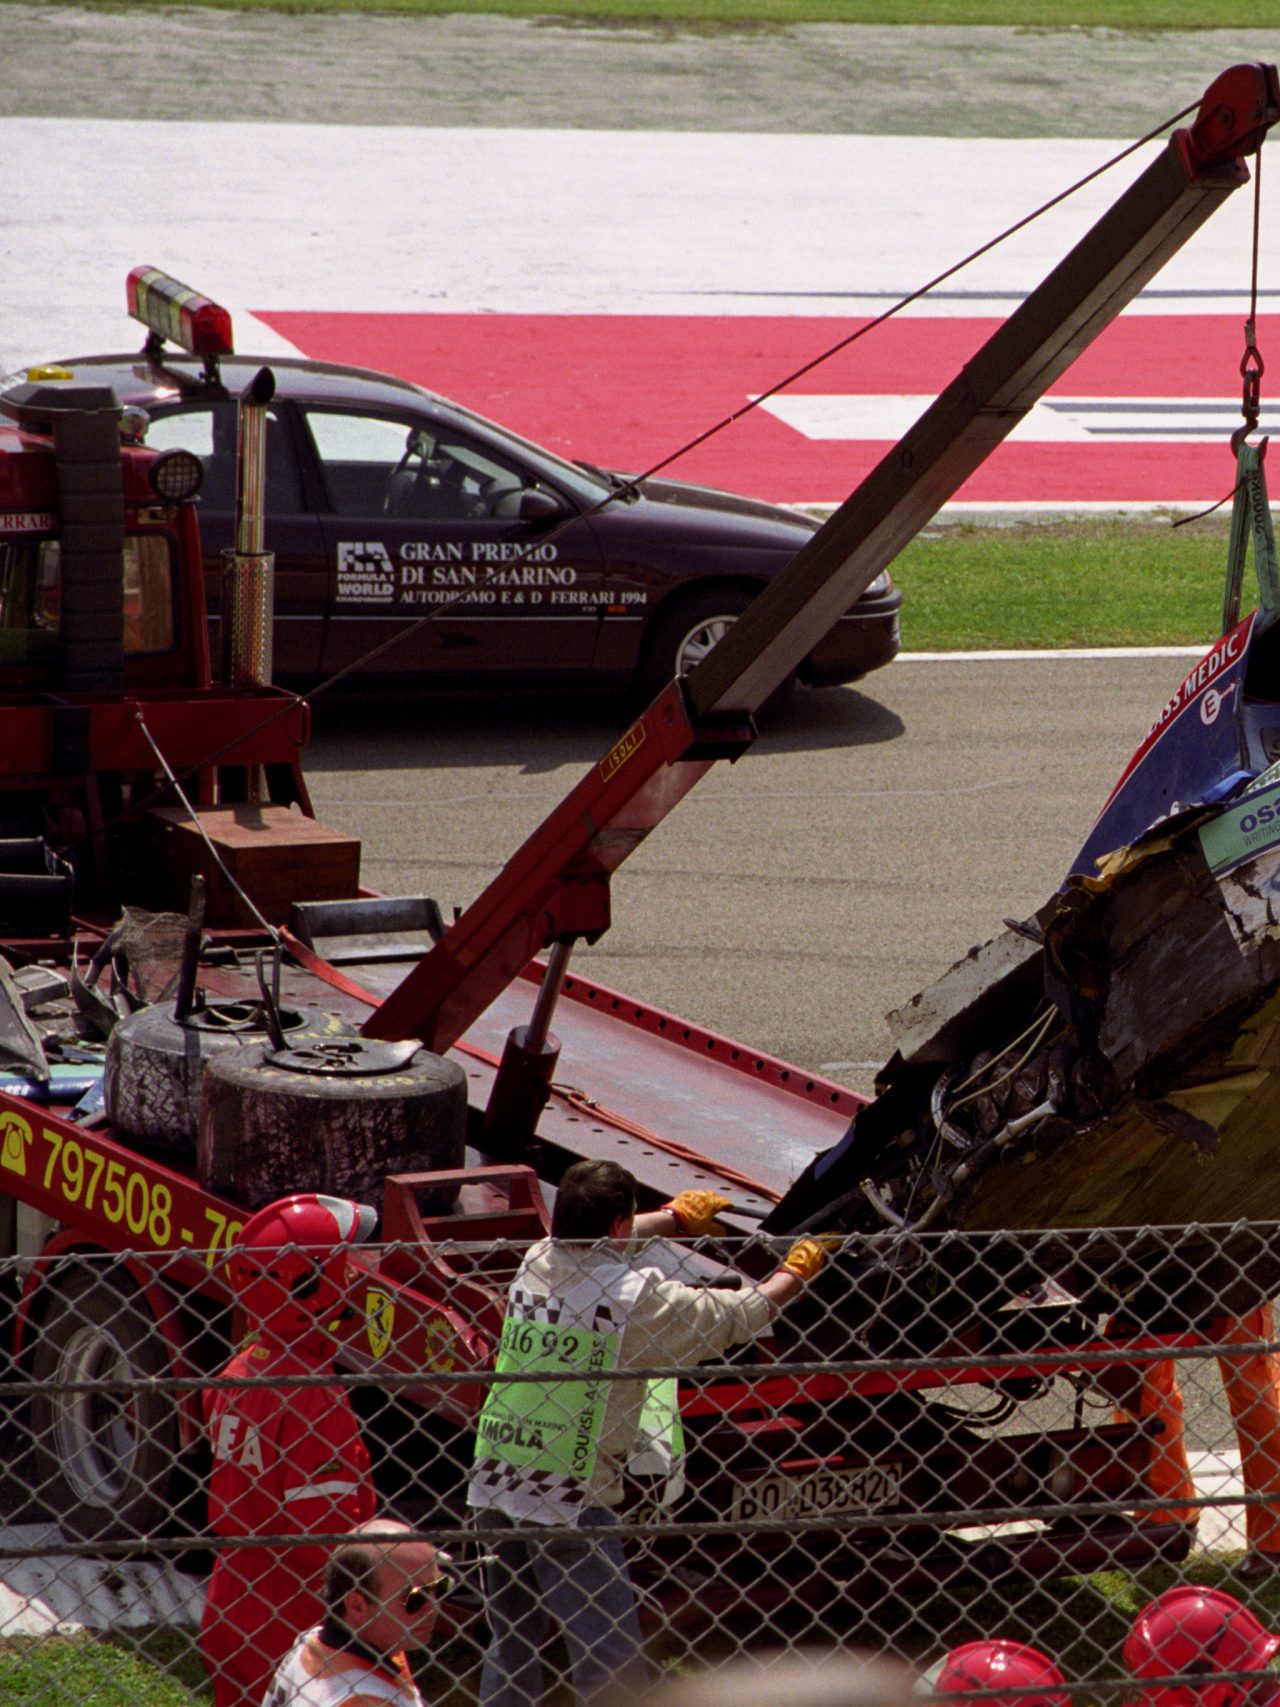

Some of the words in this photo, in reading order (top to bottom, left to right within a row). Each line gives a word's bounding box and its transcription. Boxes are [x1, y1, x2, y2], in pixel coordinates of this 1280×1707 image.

[400, 543, 462, 561] GRAN
[472, 543, 557, 561] PREMIO
[337, 583, 394, 595] WORLD
[401, 567, 424, 585] DI
[433, 567, 476, 585] SAN
[486, 567, 577, 585] MARINO
[400, 590, 496, 604] AUTODROMO
[501, 591, 512, 603] E
[514, 591, 525, 603] &
[532, 591, 542, 604] D
[551, 591, 614, 604] FERRARI
[620, 590, 648, 604] 1994
[1183, 633, 1239, 700] MEDIC
[608, 734, 636, 769] ISOLI
[43, 1128, 172, 1246] 797508
[480, 1418, 544, 1451] IMOLA
[574, 1408, 595, 1472] COURSE
